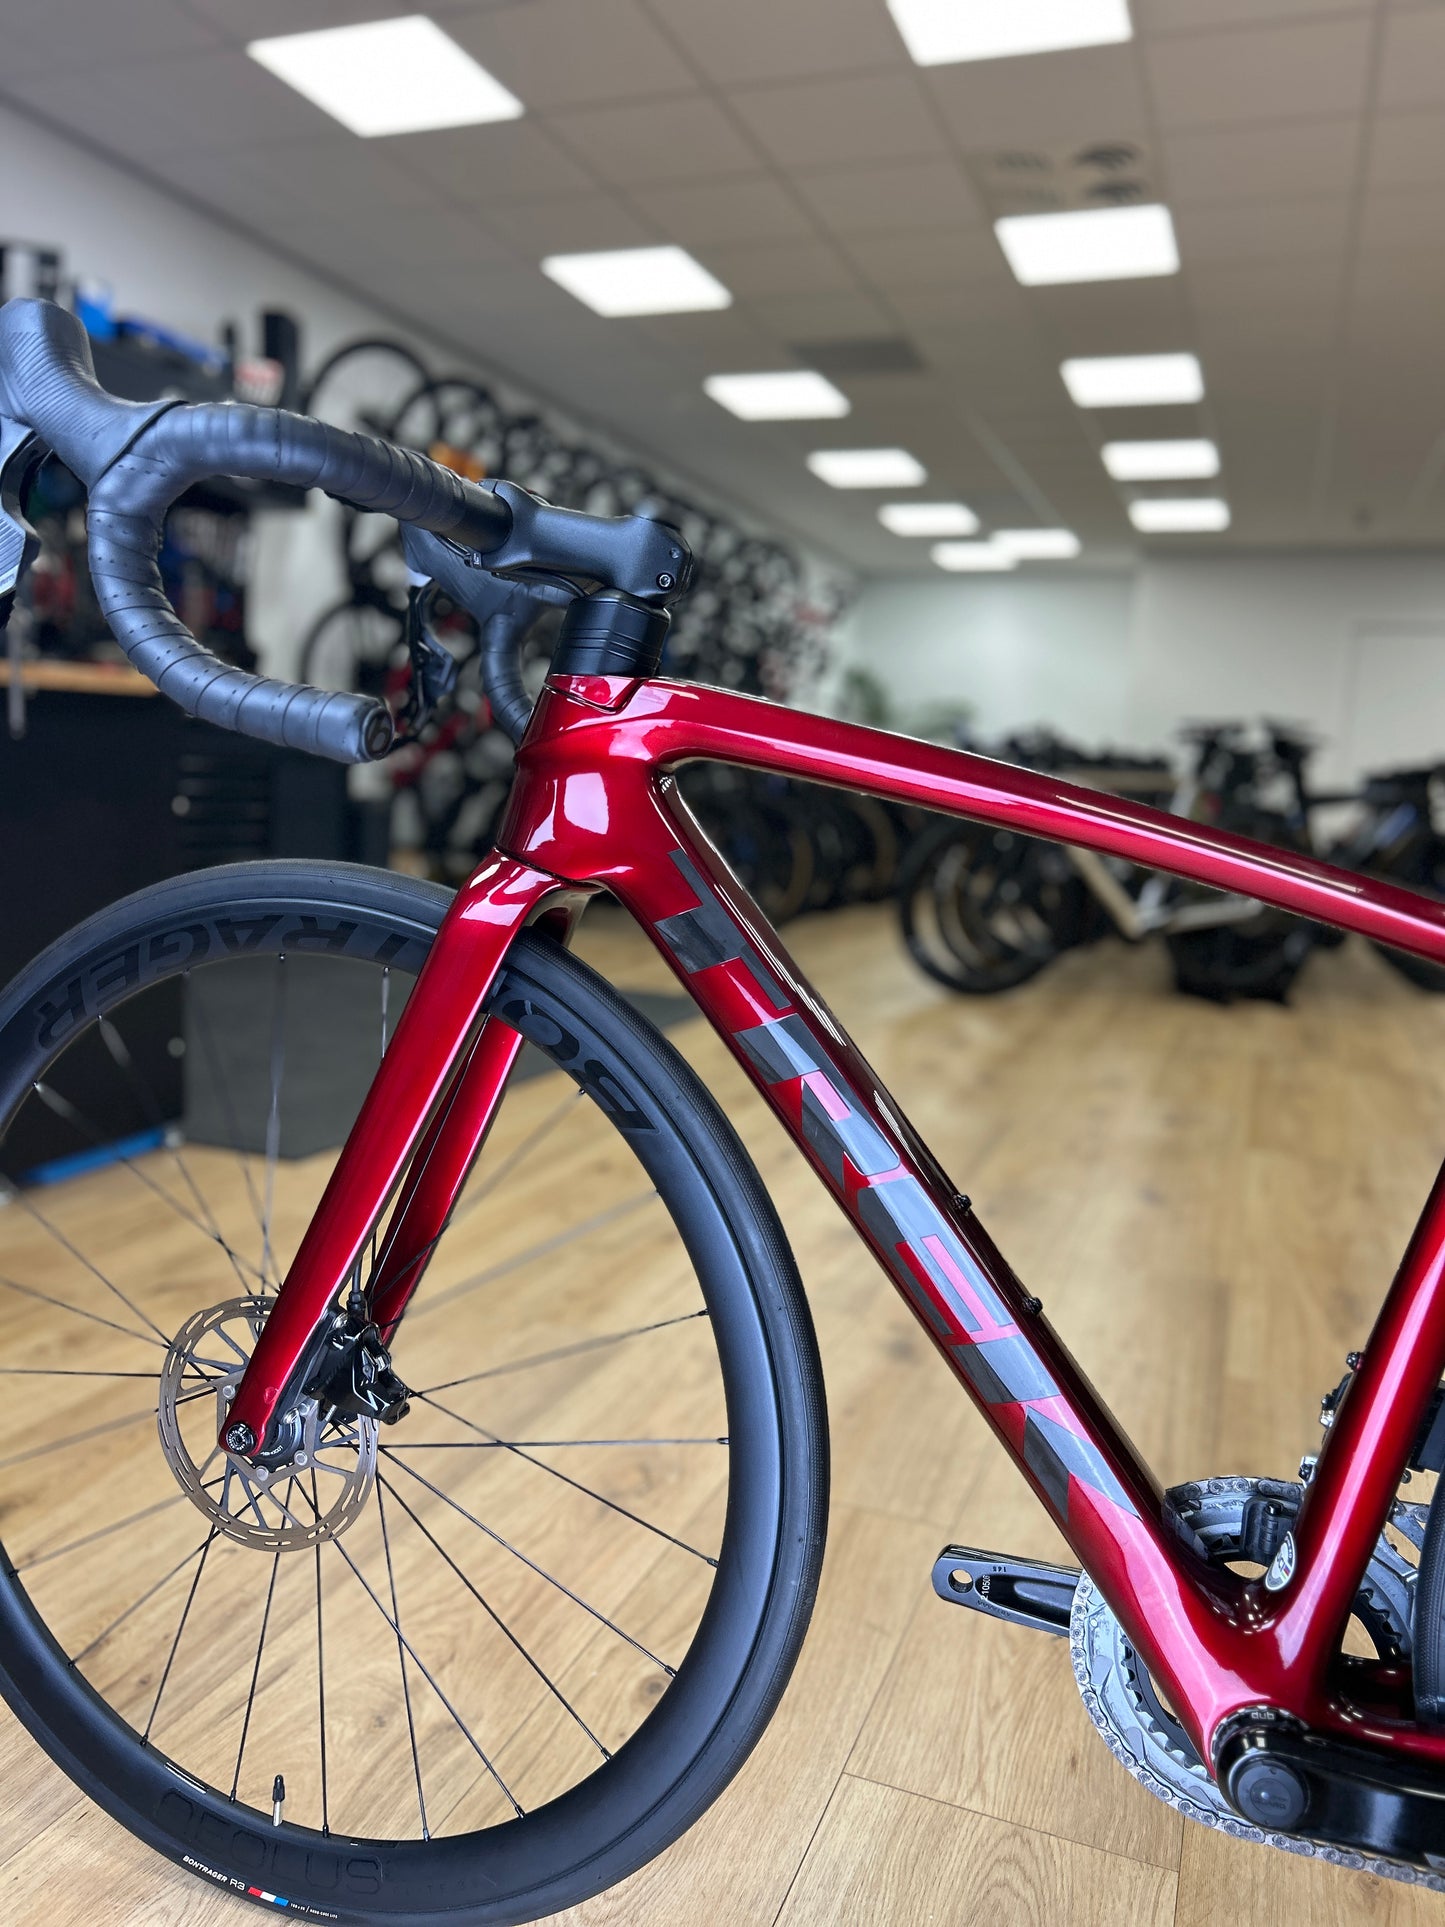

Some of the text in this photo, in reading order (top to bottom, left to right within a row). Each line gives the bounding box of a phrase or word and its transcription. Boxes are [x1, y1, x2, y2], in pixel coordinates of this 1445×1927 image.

[654, 849, 1143, 1524] TREK
[1250, 1711, 1276, 1721] dub
[182, 1855, 246, 1891] BONTRAGER R3
